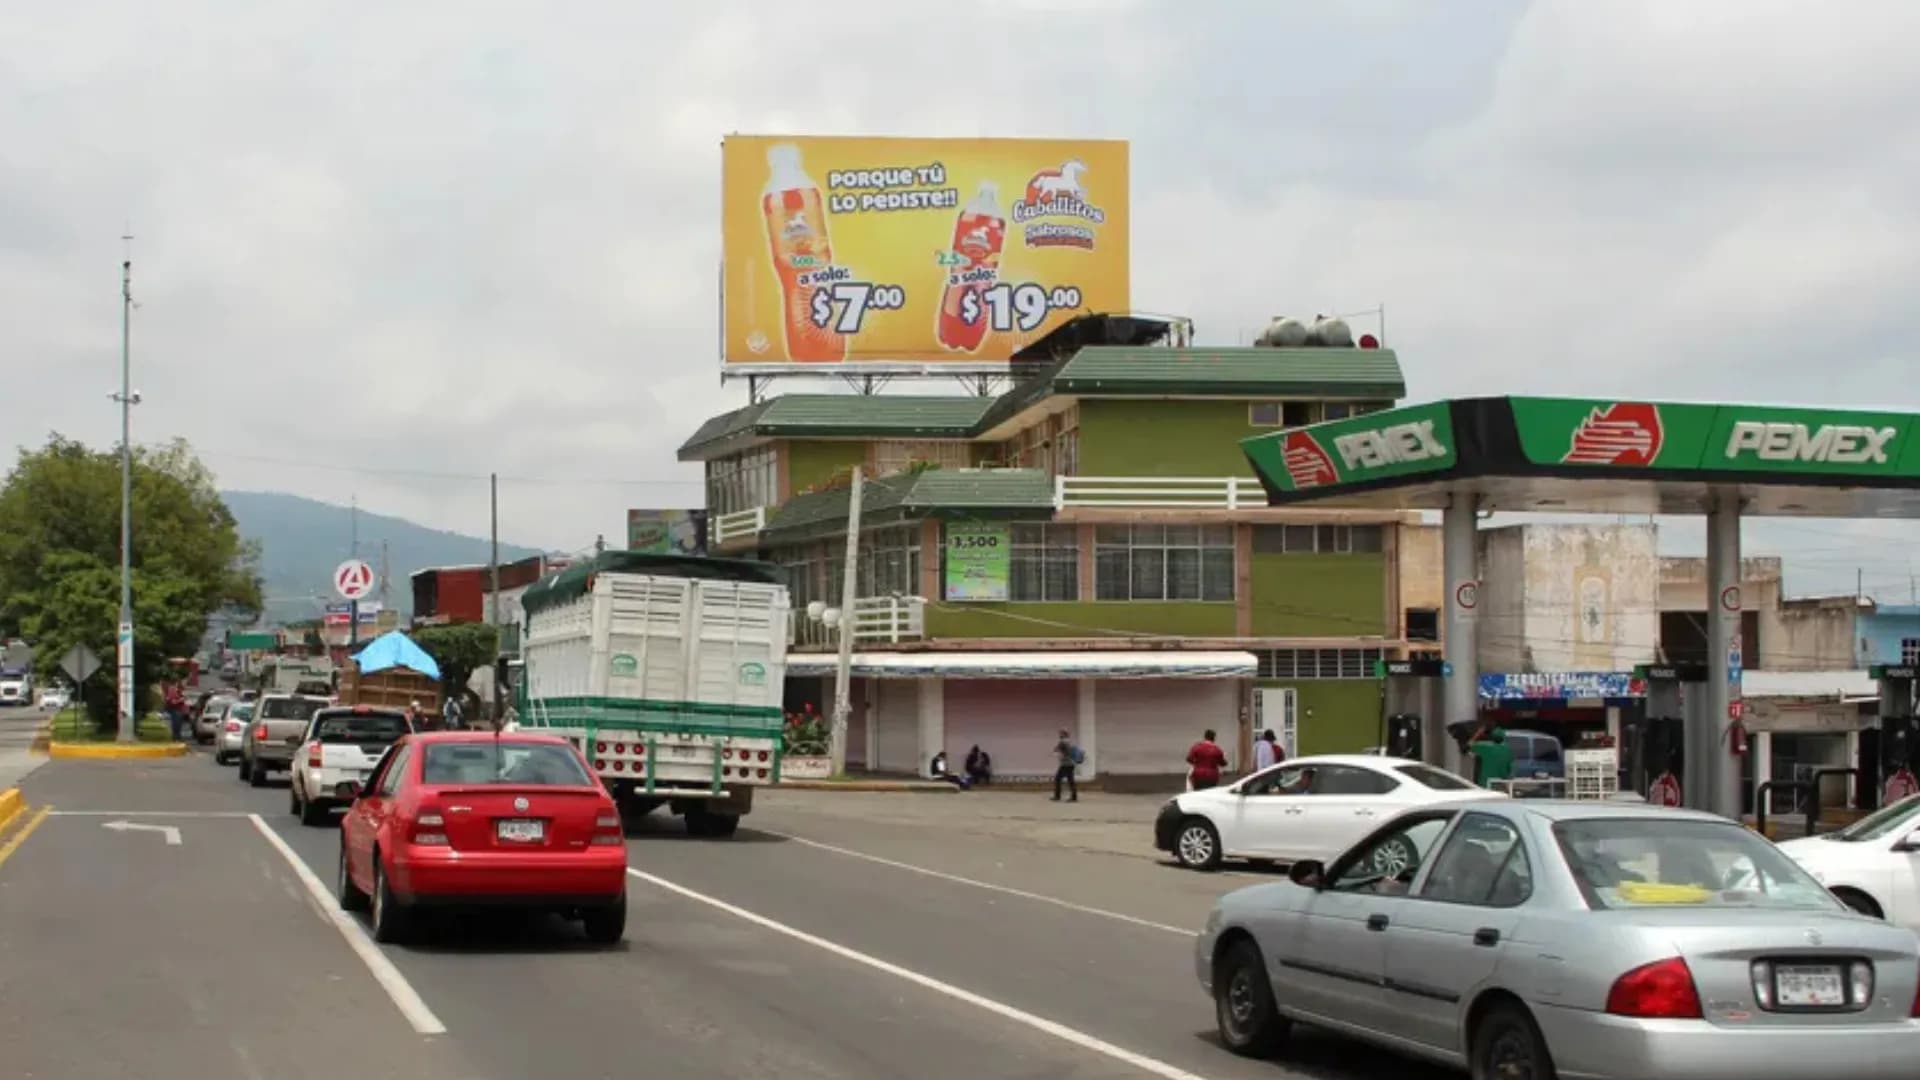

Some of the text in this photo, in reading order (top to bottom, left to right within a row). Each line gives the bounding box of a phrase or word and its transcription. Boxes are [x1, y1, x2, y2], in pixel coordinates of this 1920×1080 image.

[829, 162, 945, 189] PORQUE TÚ
[831, 194, 858, 213] LO
[800, 266, 850, 284] a solo:
[950, 268, 996, 284] a solo:
[1334, 421, 1447, 470] PEMEX
[1725, 421, 1896, 463] PEMEX
